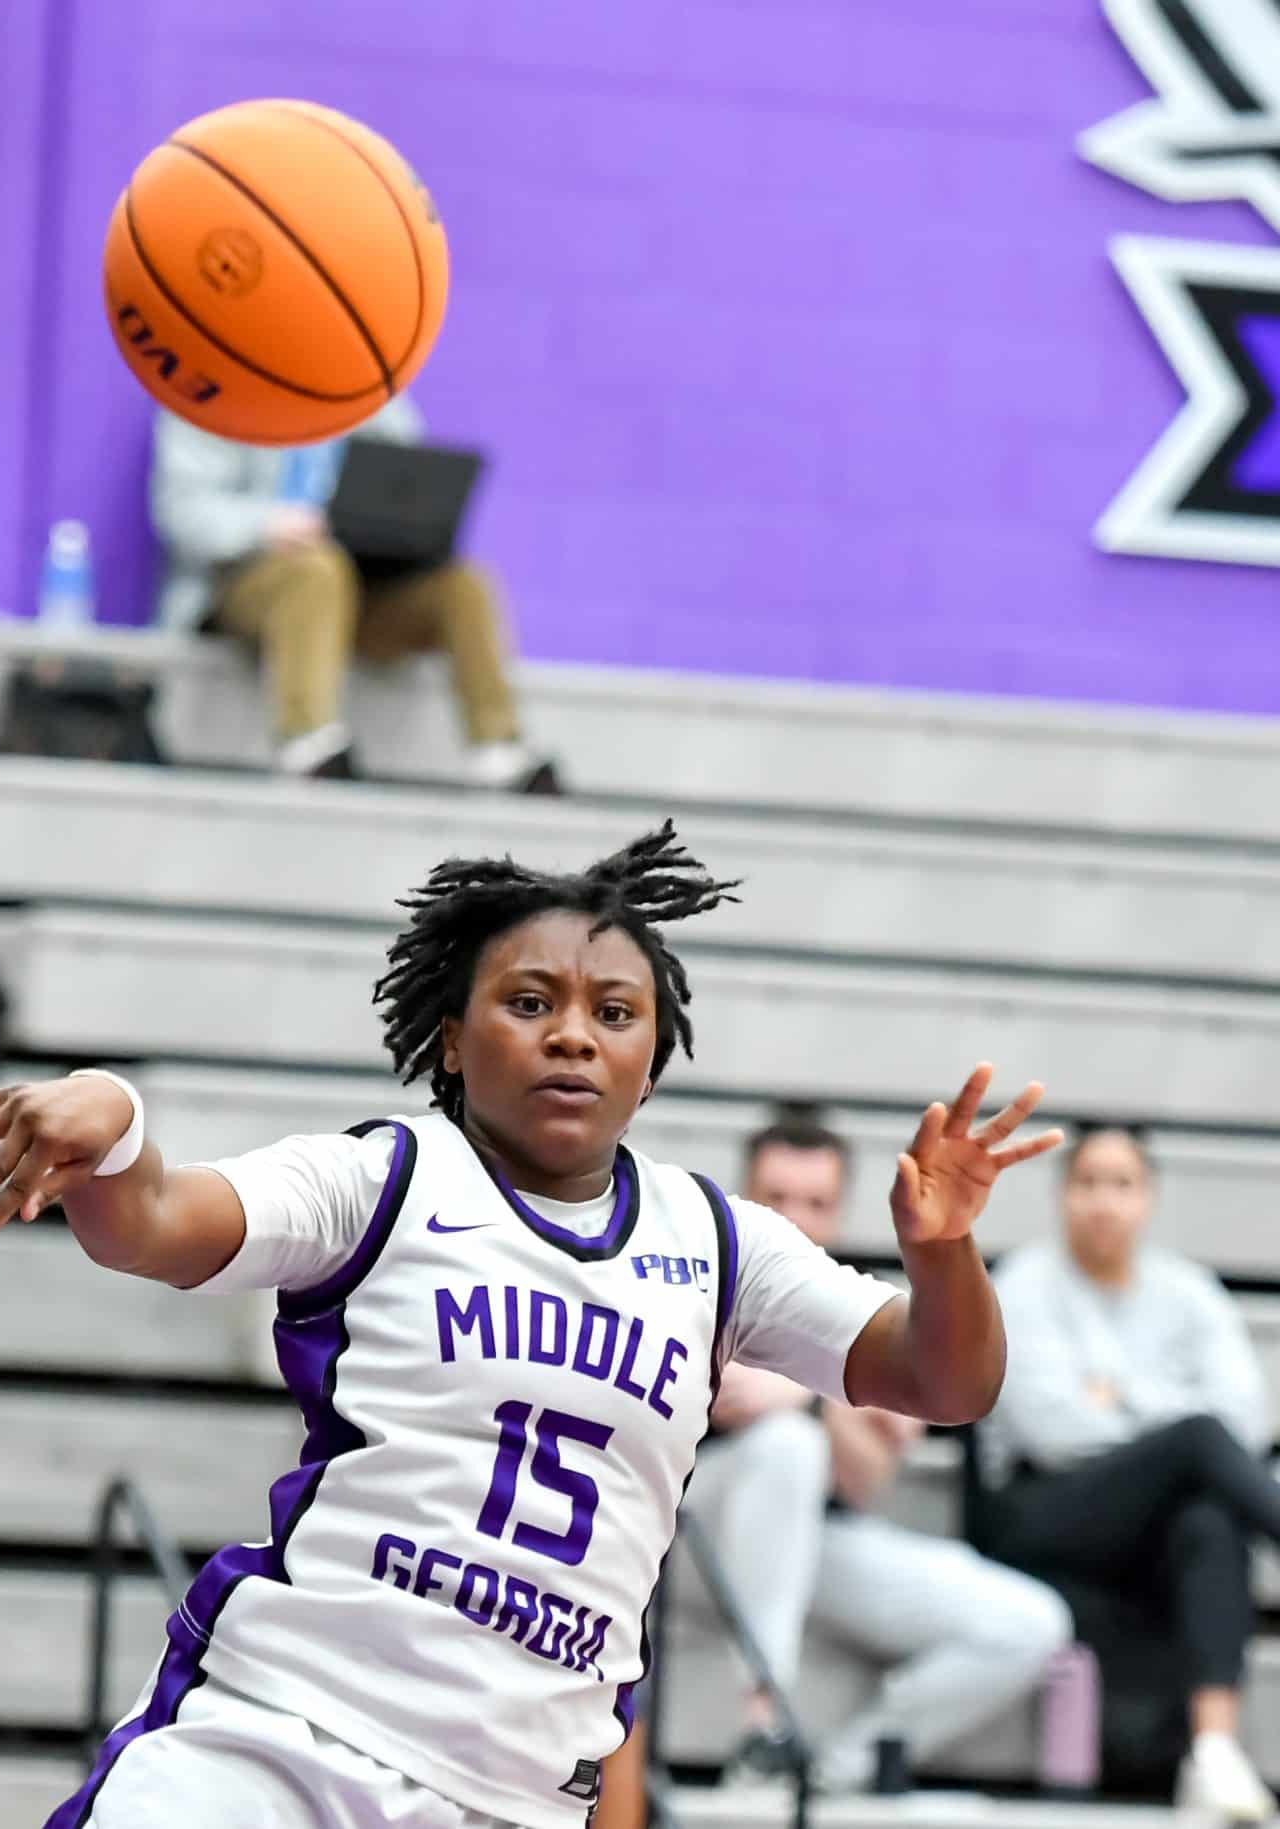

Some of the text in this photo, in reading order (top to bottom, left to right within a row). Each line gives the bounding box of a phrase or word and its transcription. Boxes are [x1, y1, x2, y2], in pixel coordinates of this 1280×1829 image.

[630, 1254, 710, 1293] PBC
[435, 1286, 688, 1420] MIDDLE
[476, 1400, 615, 1567] 15
[371, 1533, 613, 1682] GEORGIA
